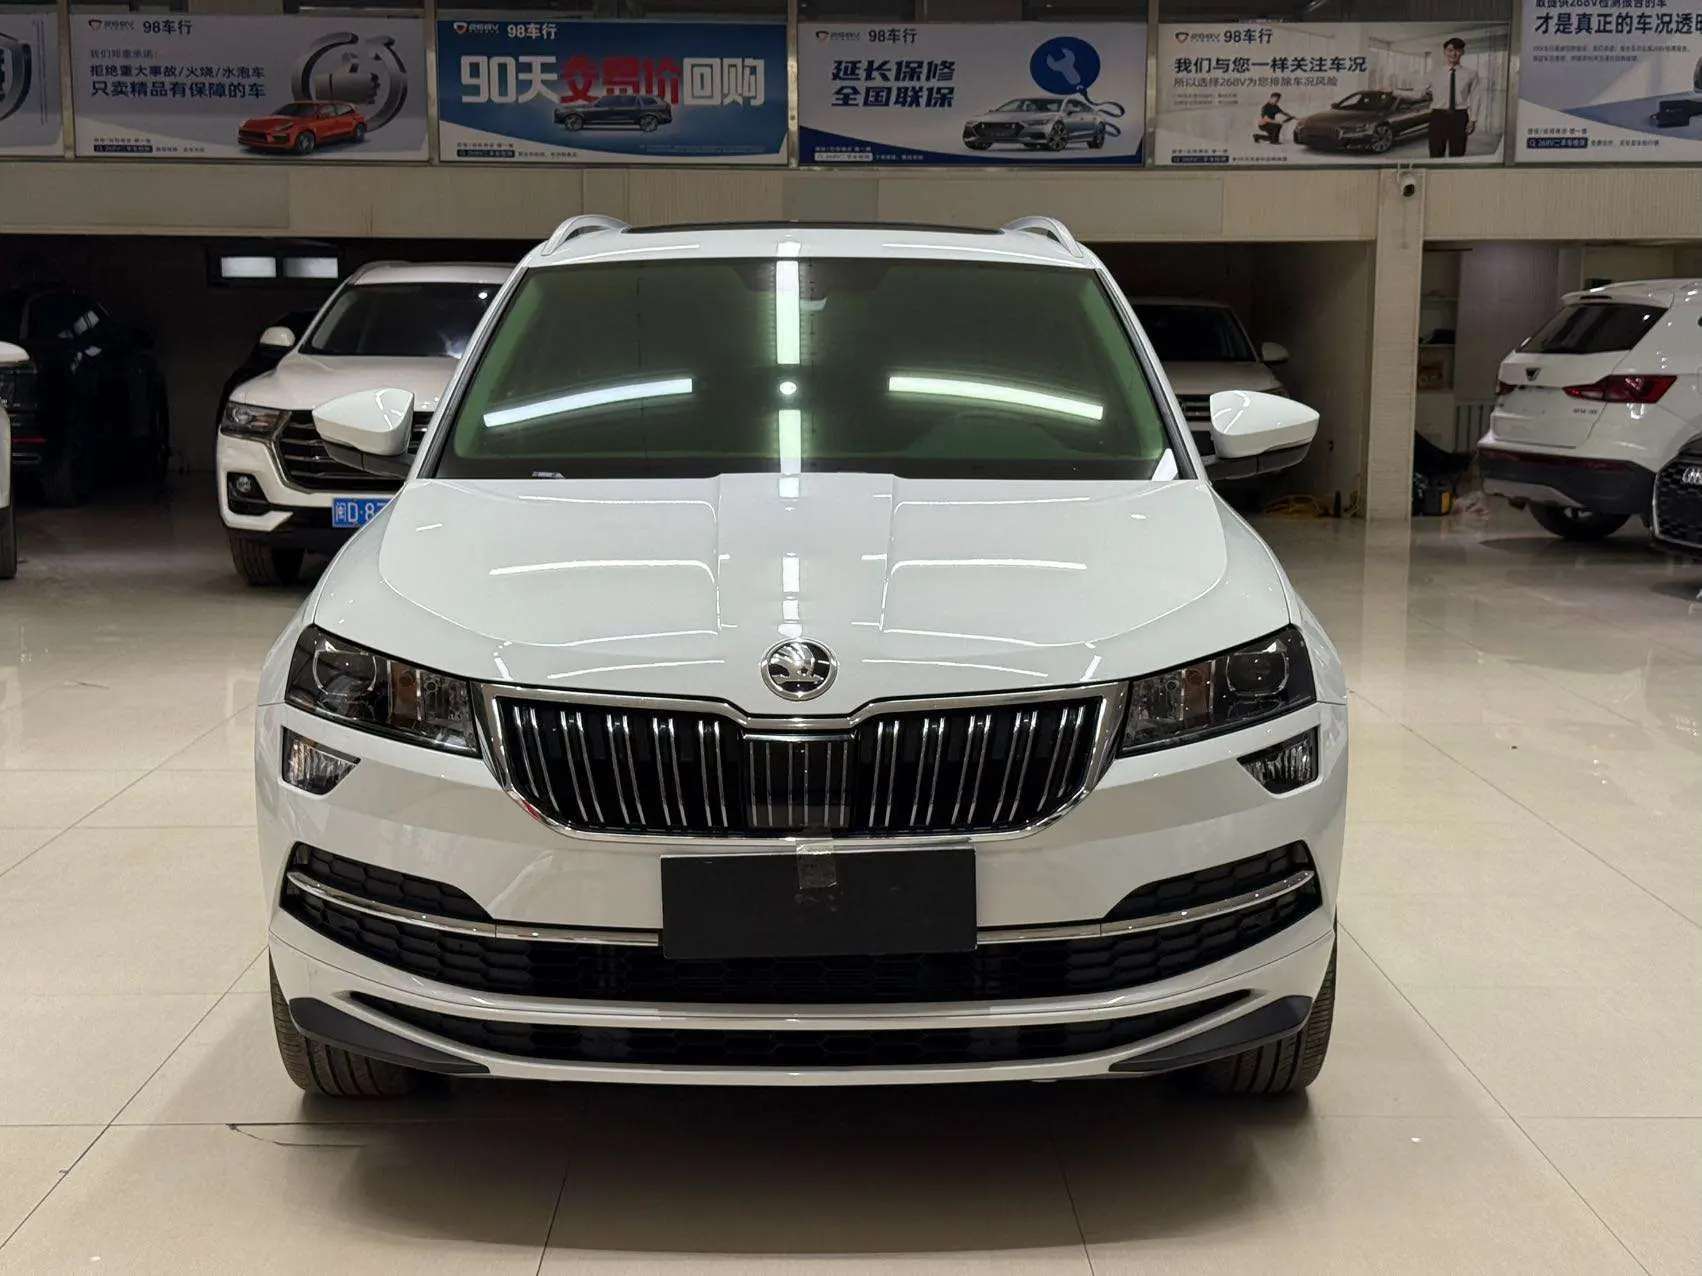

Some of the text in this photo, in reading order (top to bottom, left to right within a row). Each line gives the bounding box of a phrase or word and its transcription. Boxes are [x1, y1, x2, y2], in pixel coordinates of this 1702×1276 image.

[143, 20, 192, 36] 98车行
[507, 23, 558, 40] 98车行
[868, 28, 918, 44] 98车行
[1223, 28, 1273, 45] 98车行
[831, 60, 956, 82] 延长保修
[1174, 56, 1368, 74] 我们与您一样关注车况
[460, 54, 765, 107] 90天交易价回购
[1173, 76, 1339, 88] 所以选择268V为您排除车况风险
[90, 80, 266, 99] 只卖精品有保障的车
[831, 85, 955, 108] 全国联保
